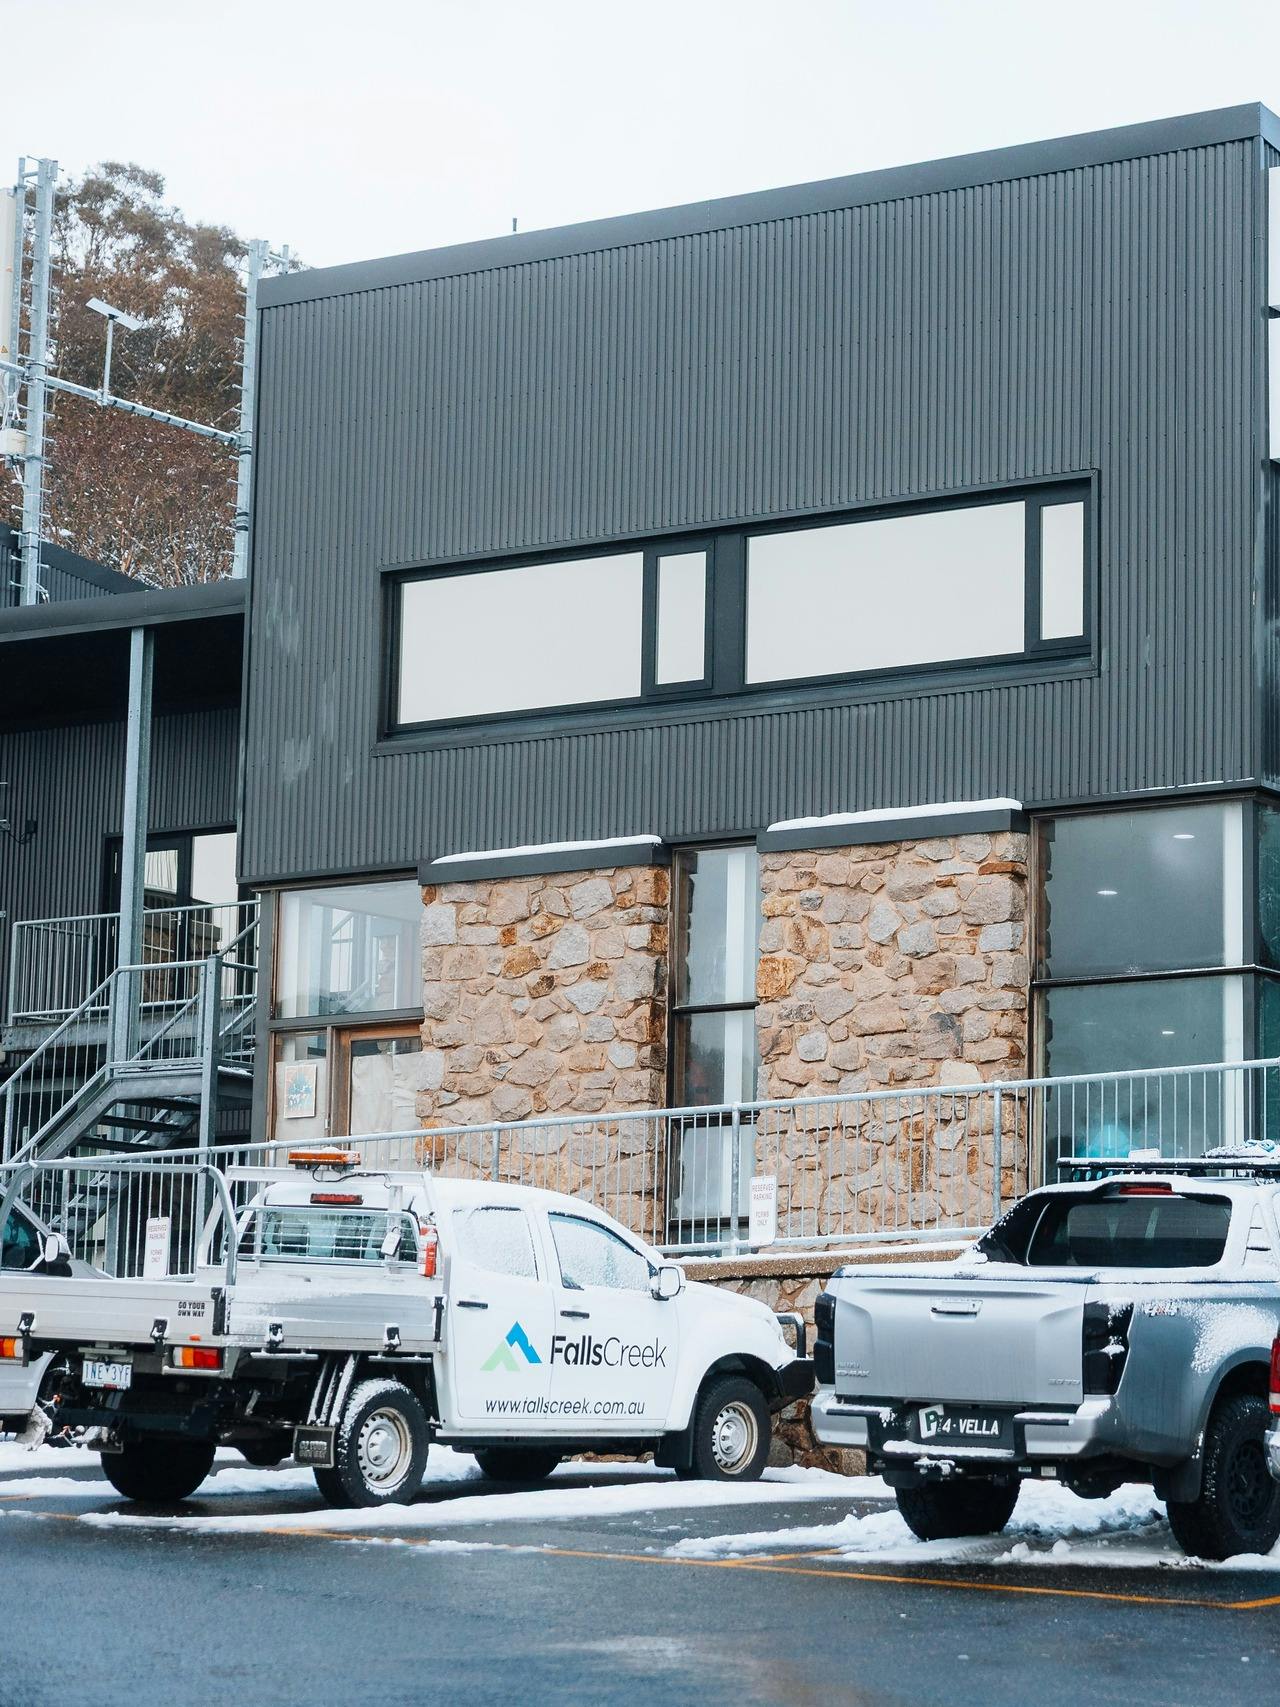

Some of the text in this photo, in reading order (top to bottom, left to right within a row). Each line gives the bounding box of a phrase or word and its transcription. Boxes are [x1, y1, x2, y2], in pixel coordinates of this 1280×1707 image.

[752, 1183, 774, 1192] RESERVED
[753, 1192, 772, 1200] PARKING
[178, 1301, 205, 1310] GO YOUR
[177, 1309, 205, 1318] OWN WAY
[550, 1335, 667, 1367] FallsCreek
[485, 1396, 646, 1415] www.fallscreek.com.au
